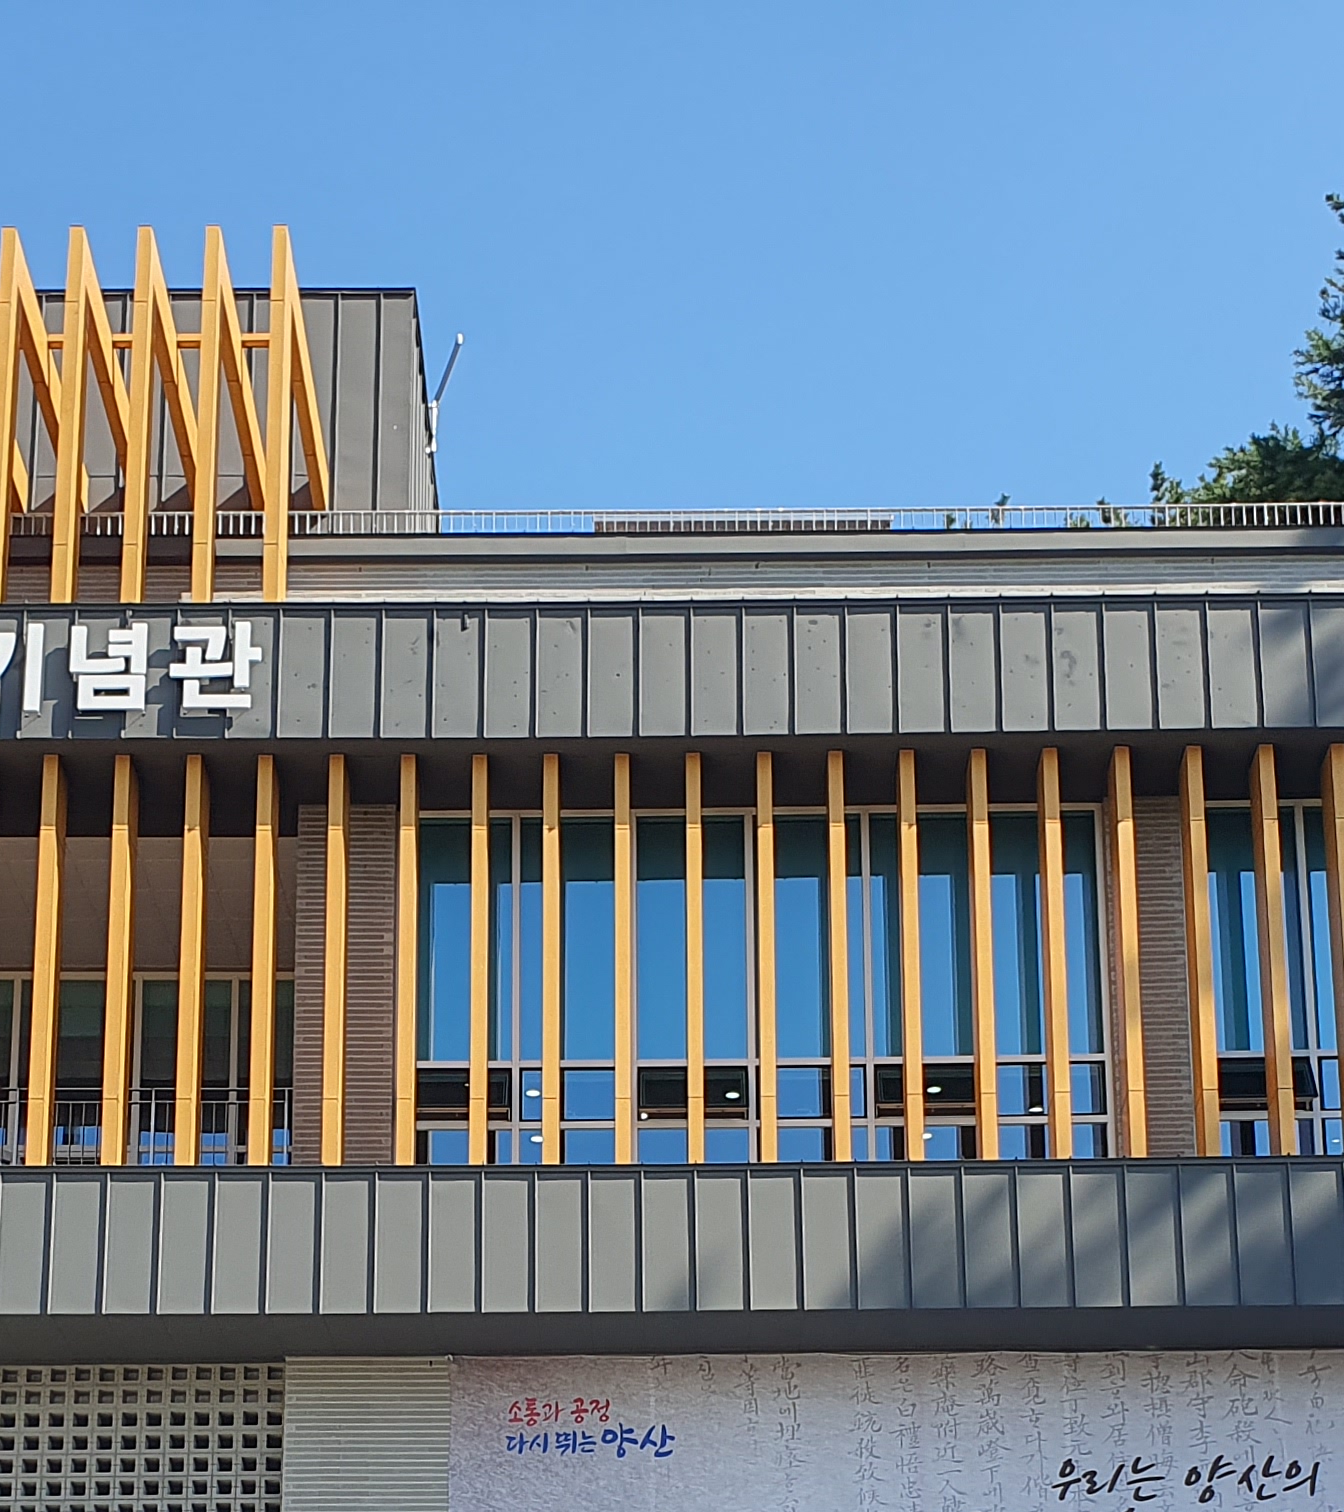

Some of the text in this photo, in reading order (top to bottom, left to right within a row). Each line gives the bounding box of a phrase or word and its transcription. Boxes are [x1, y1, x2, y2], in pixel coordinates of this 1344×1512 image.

[507, 1397, 611, 1427] 소통과 공정
[506, 1422, 676, 1459] 다시 뛰는 양산
[1050, 1453, 1321, 1504] 우리는 양산의
